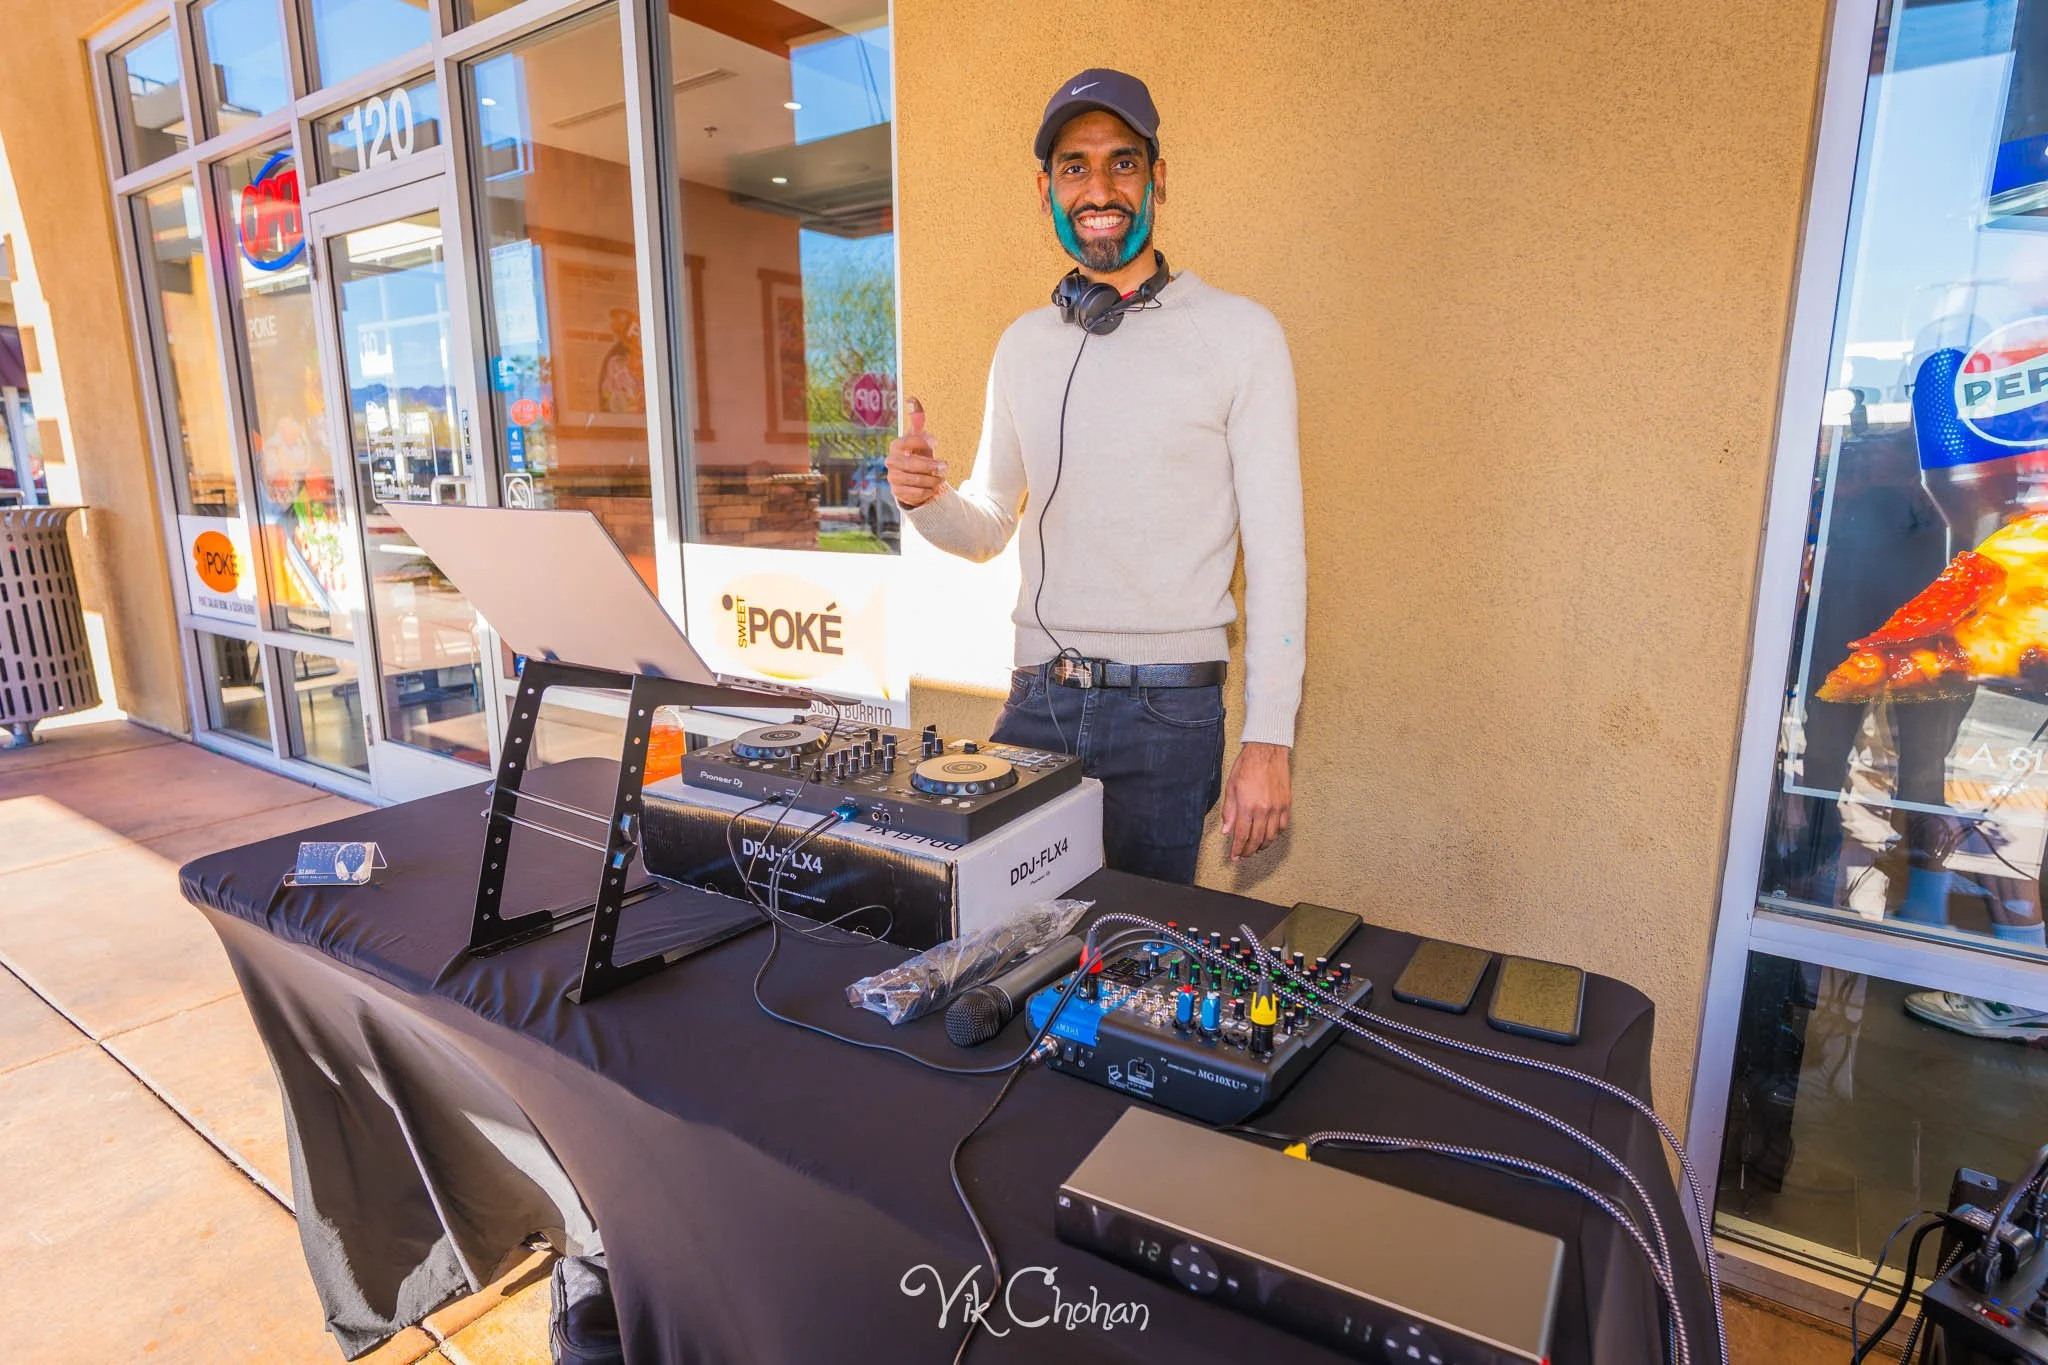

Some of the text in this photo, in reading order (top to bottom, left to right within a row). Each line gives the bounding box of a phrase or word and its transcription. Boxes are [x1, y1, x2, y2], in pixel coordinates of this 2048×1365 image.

[348, 88, 414, 172] 120
[240, 169, 304, 255] OPE
[736, 594, 749, 649] SWEET
[748, 602, 843, 656] POKÉ
[845, 703, 892, 726] BURRITO
[700, 770, 732, 783] Pioneer
[1010, 837, 1069, 886] DDJ-FLX4
[1053, 1023, 1079, 1037] AMAHA
[1198, 1068, 1240, 1090] MG10XU
